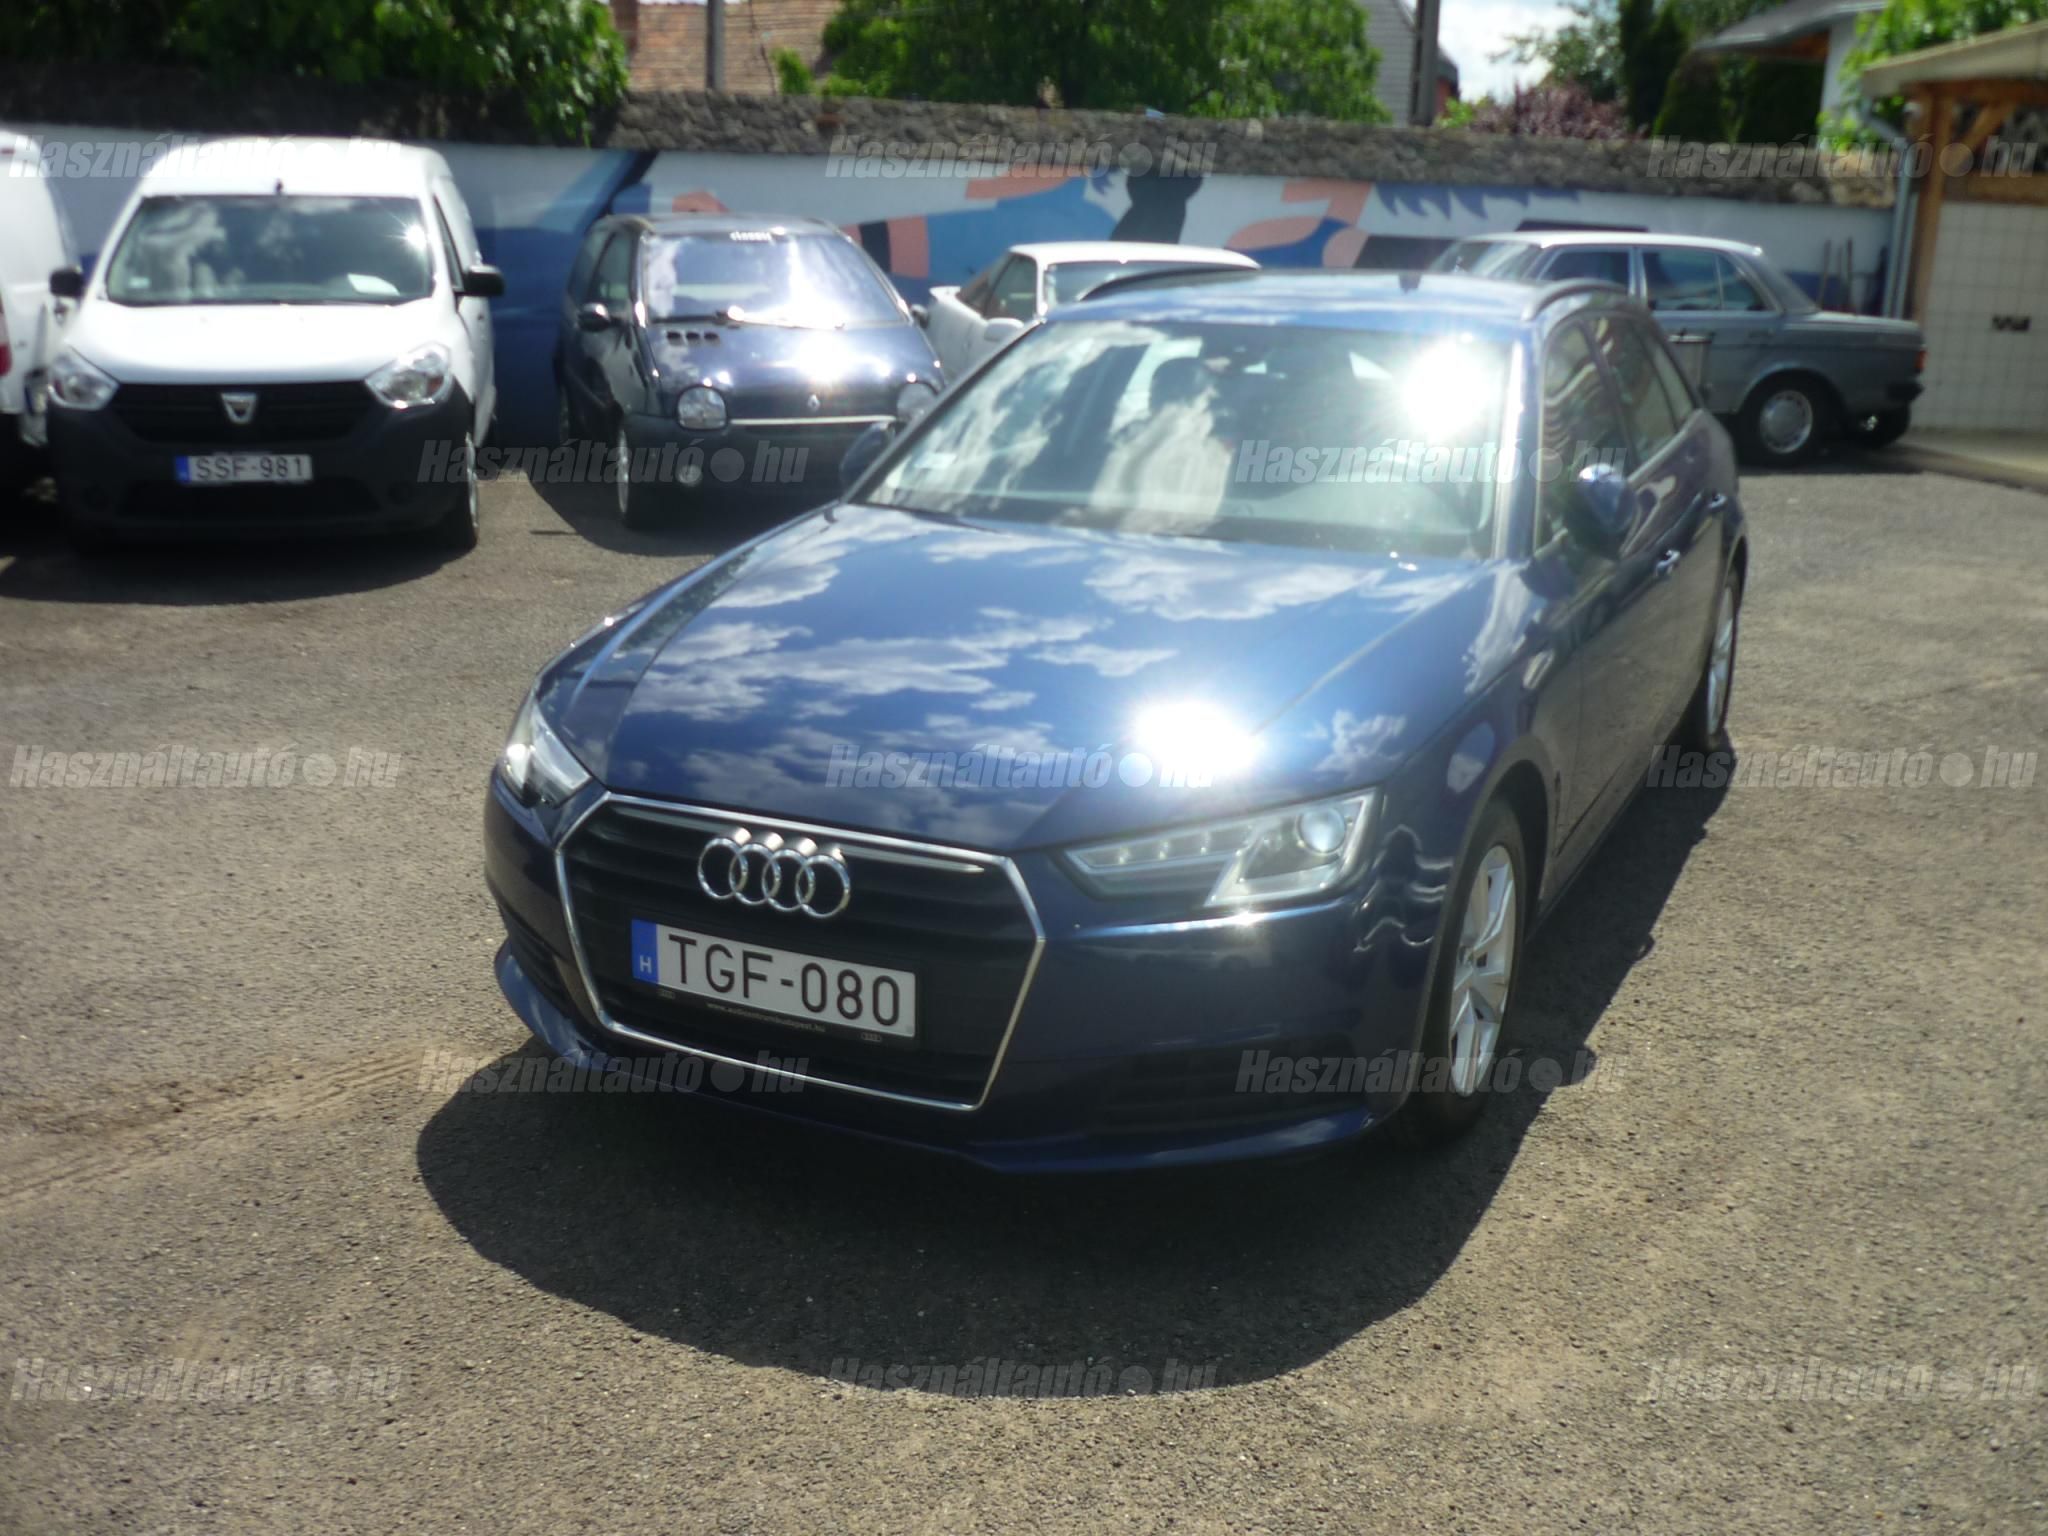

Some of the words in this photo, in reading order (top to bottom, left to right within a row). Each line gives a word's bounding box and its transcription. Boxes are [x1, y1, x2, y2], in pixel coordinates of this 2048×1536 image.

[195, 455, 303, 480] SSF-981
[638, 954, 653, 974] H
[668, 933, 900, 1027] TGF-080
